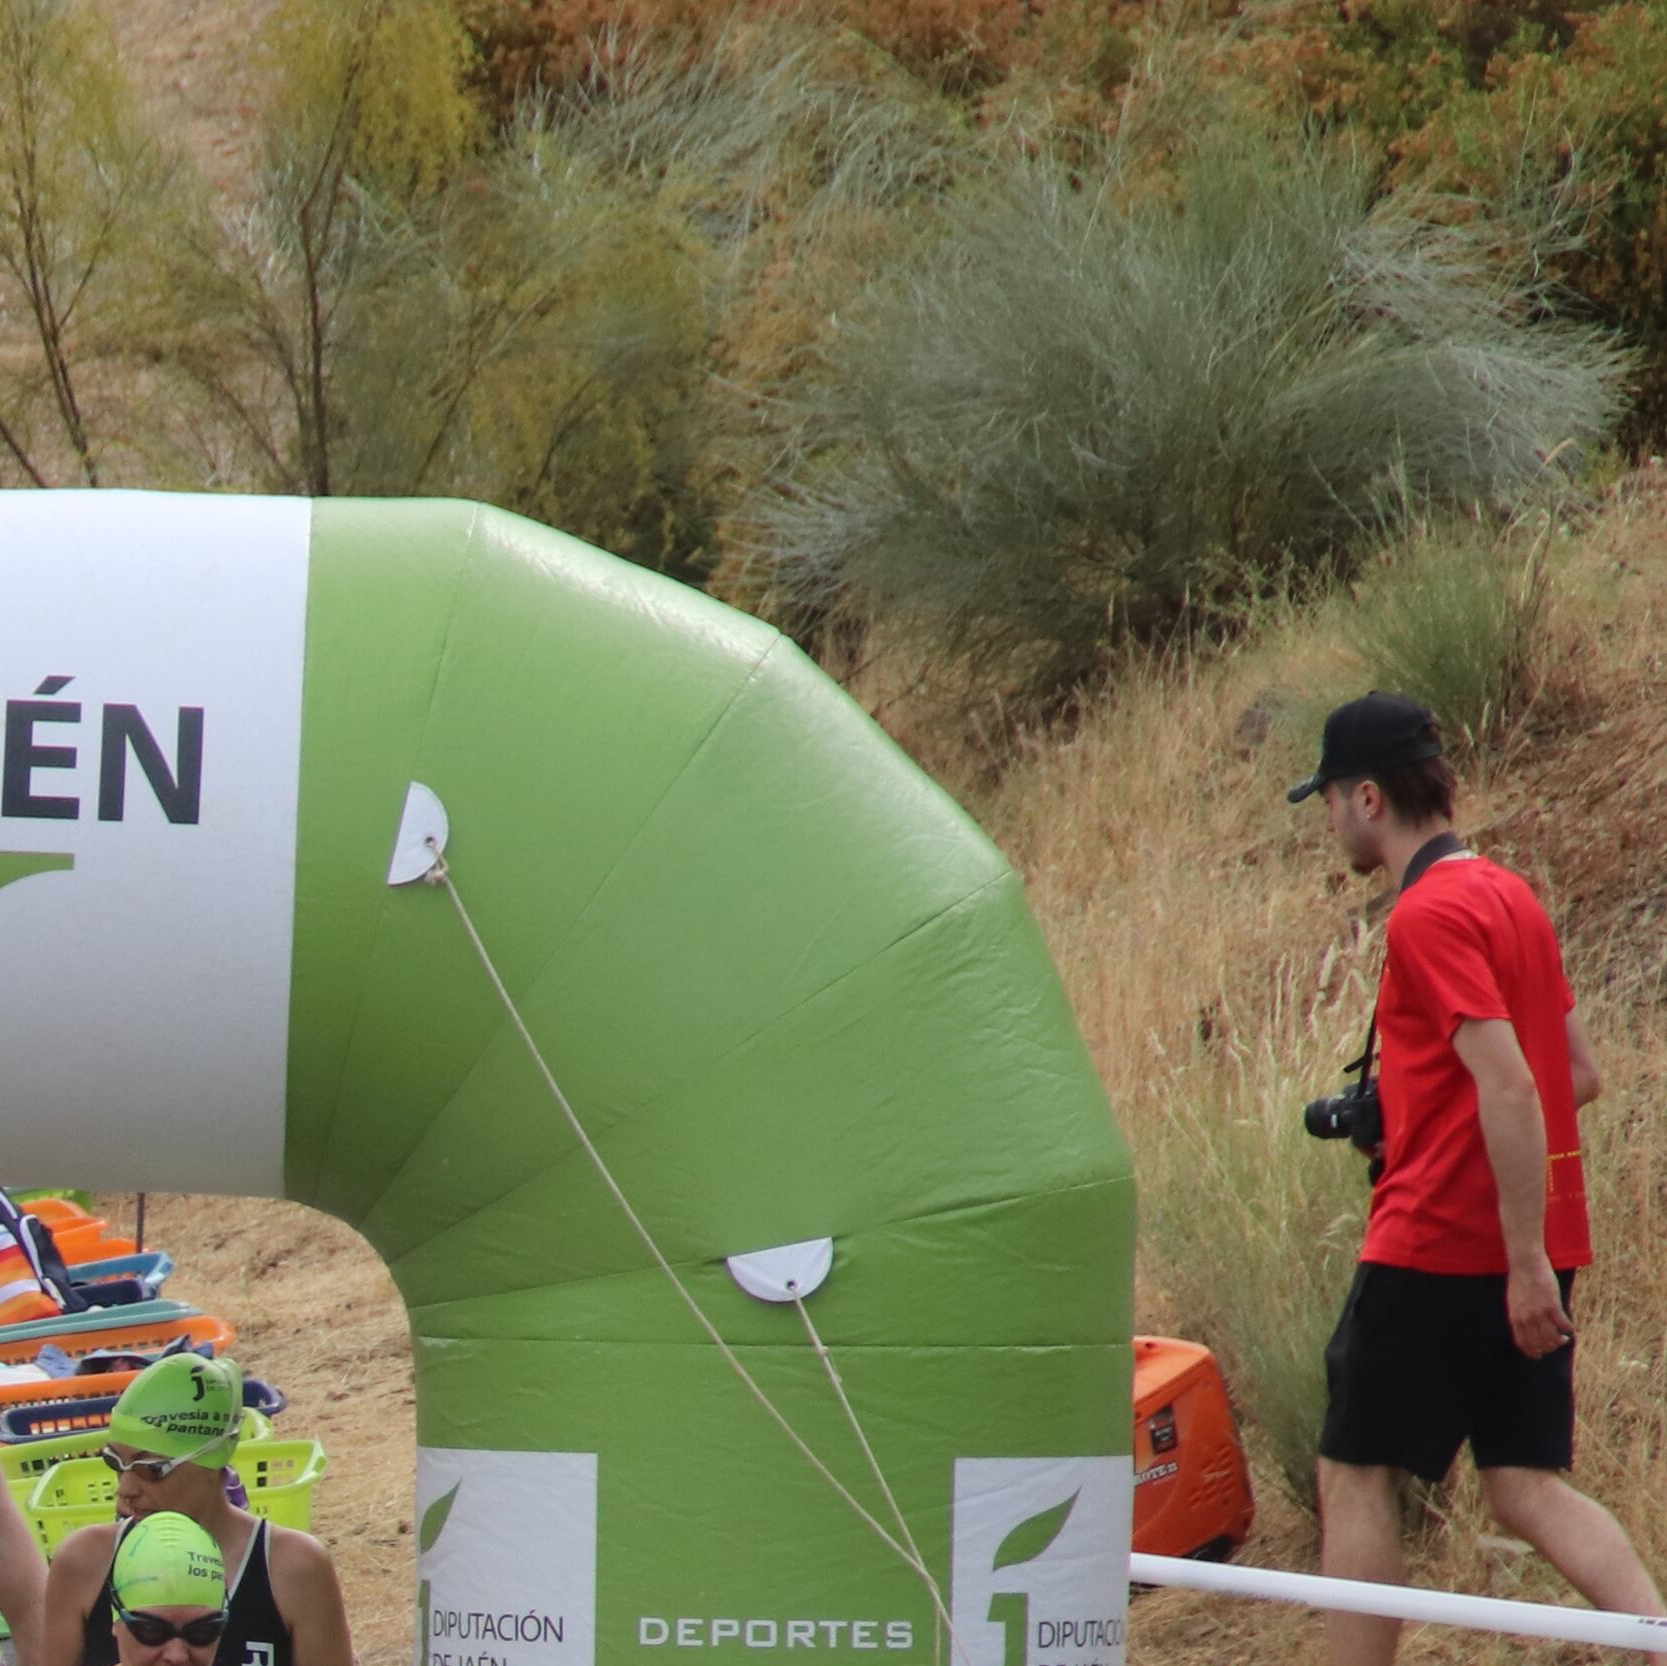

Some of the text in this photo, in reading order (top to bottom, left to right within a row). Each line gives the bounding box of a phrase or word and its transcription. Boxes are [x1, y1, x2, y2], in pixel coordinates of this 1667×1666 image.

[166, 1424, 226, 1437] pantan
[188, 1564, 208, 1578] los
[432, 1609, 564, 1644] DIPUTACIÓN
[638, 1616, 914, 1649] DEPORTES
[1038, 1614, 1123, 1648] DIPUTAC
